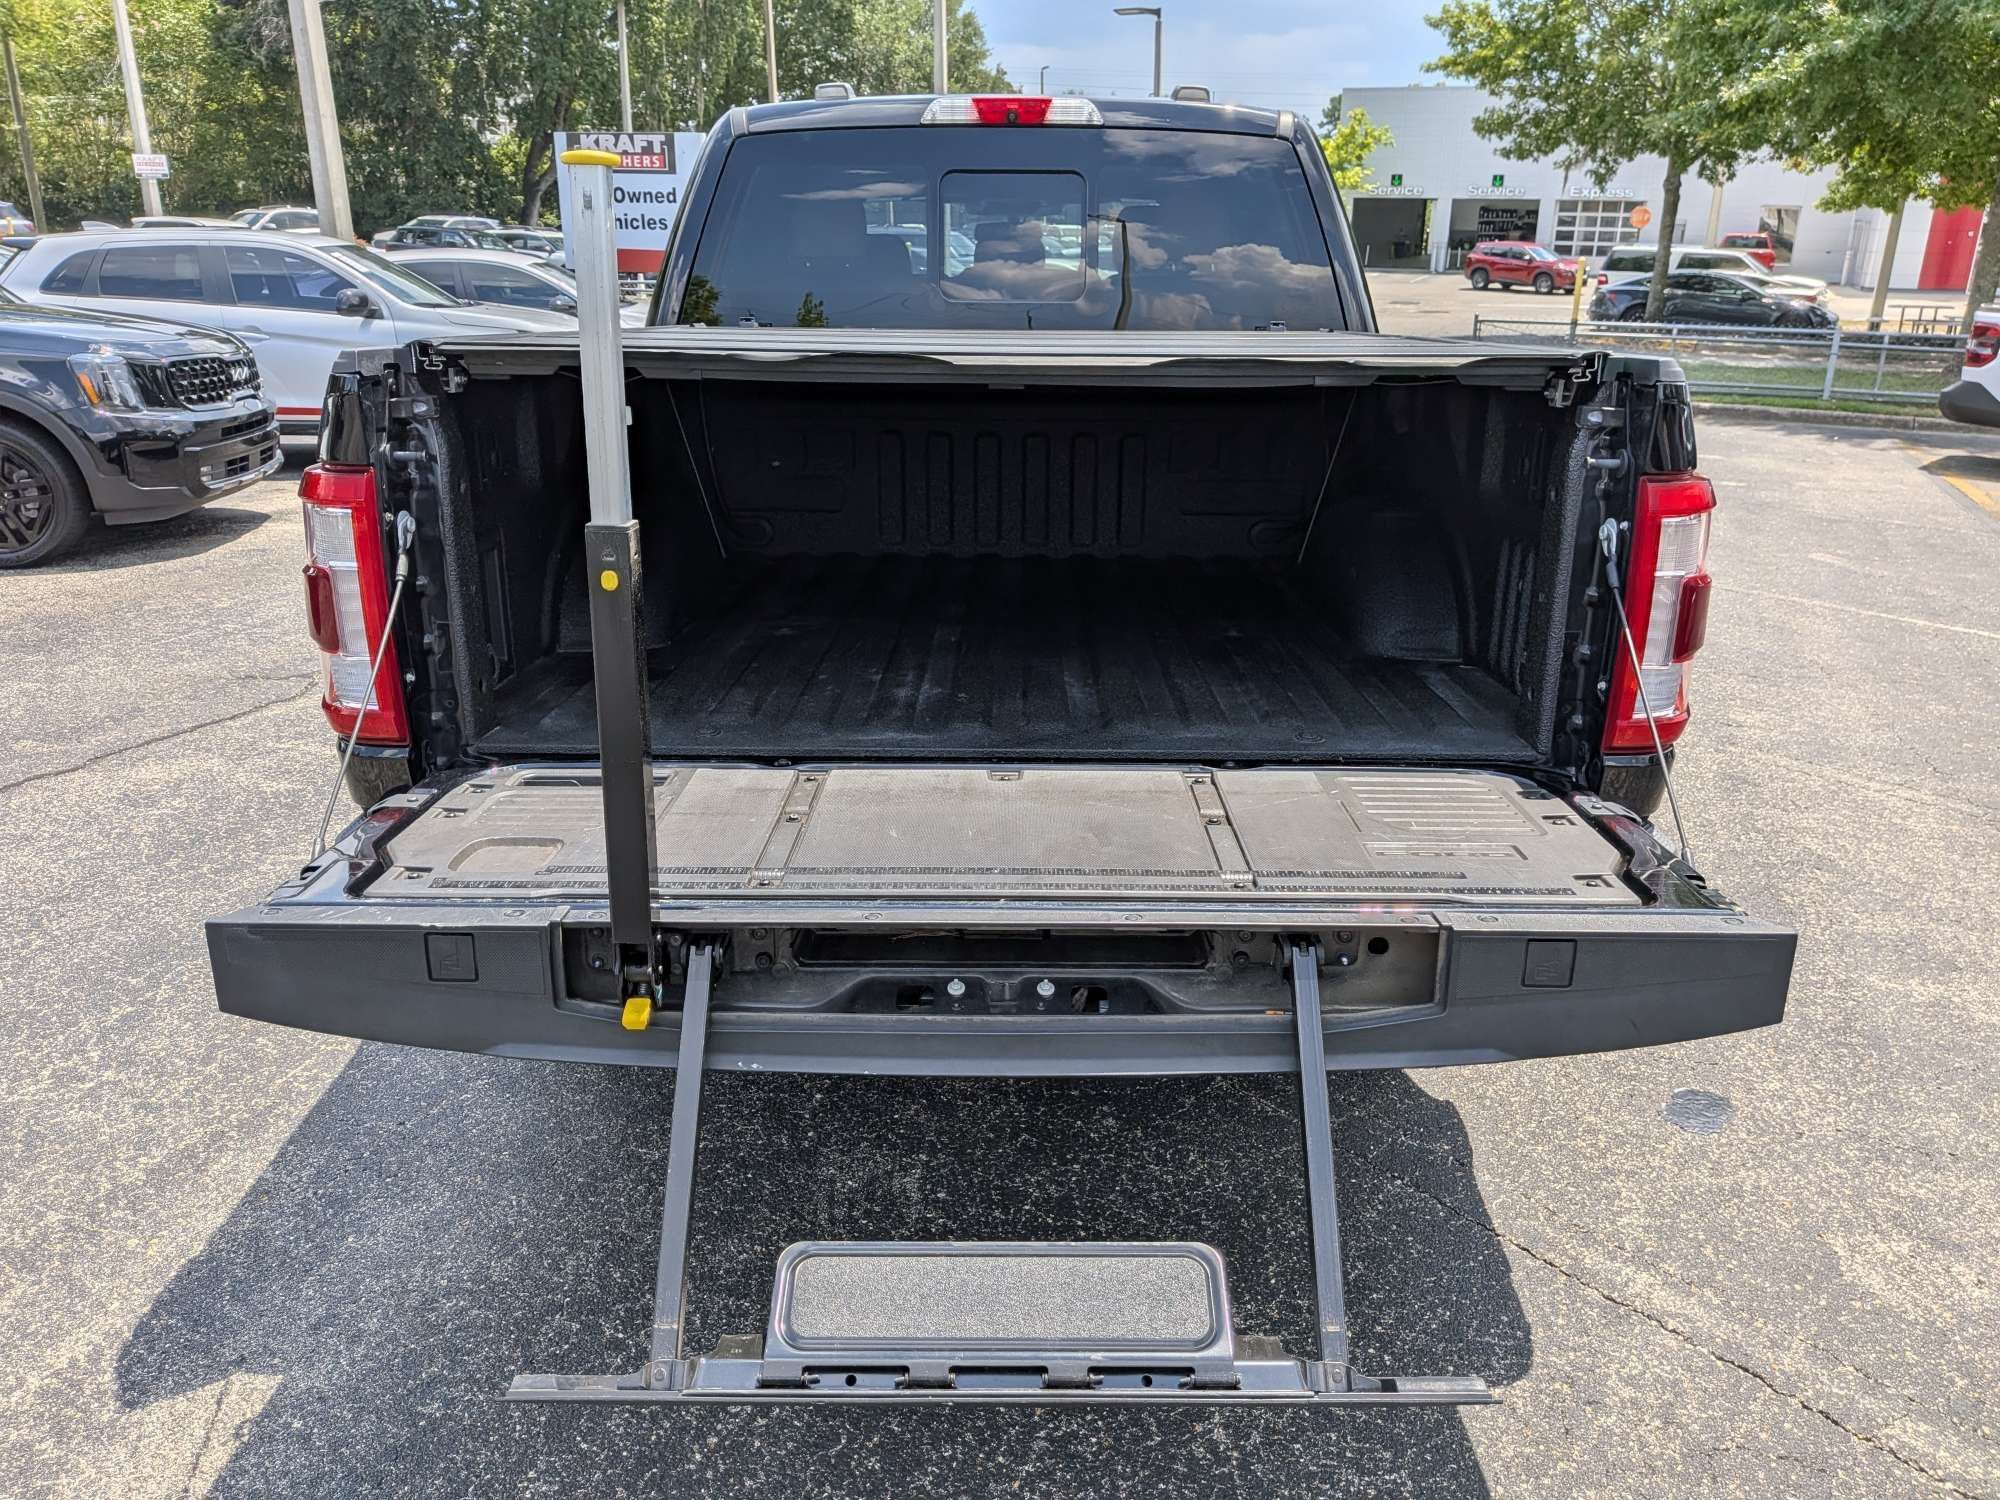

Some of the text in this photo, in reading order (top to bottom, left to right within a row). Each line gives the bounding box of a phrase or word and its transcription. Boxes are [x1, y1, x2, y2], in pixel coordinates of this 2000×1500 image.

[580, 134, 666, 153] KRAFT
[622, 155, 661, 167] HERS
[1368, 184, 1424, 196] Service
[1468, 184, 1525, 196] Service
[615, 213, 668, 230] hicles
